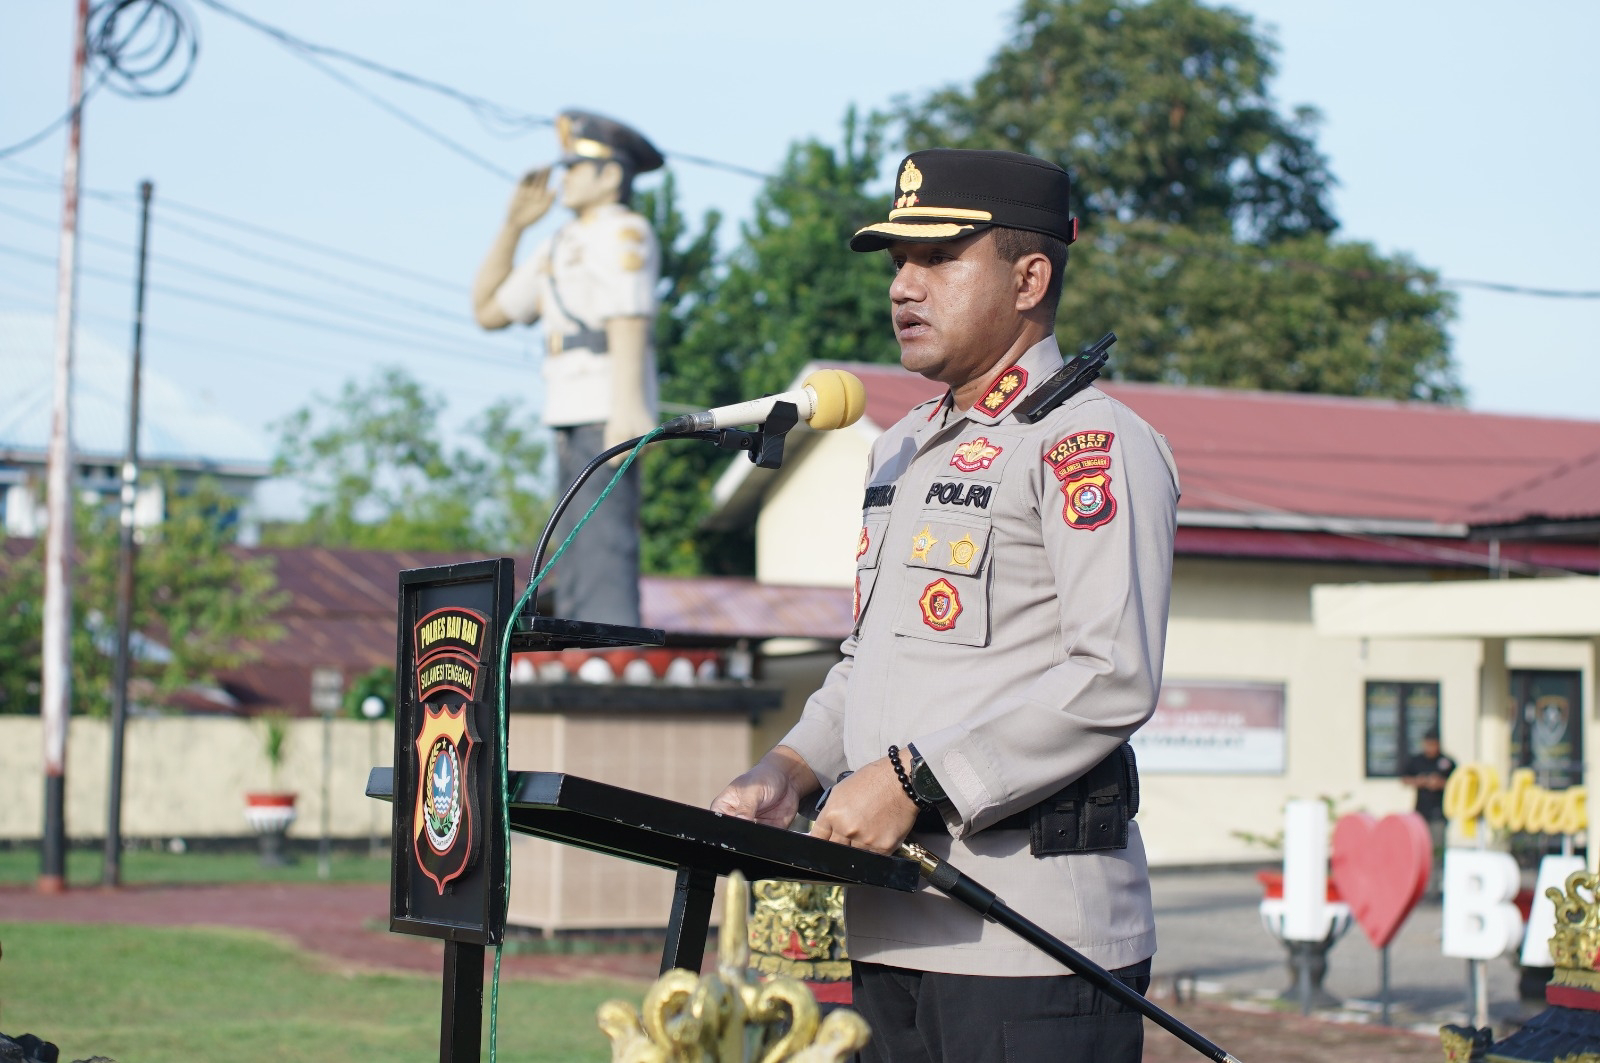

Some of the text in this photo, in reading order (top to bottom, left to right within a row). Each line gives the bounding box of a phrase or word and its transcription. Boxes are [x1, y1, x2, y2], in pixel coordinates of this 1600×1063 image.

[1050, 434, 1107, 460] POLRES
[1057, 441, 1102, 462] BAU BAU
[925, 482, 993, 509] POLRI
[421, 616, 478, 649] POLRES BAU BAU
[421, 663, 472, 689] SULAWESI TENGGARA
[1443, 763, 1590, 838] Polres
